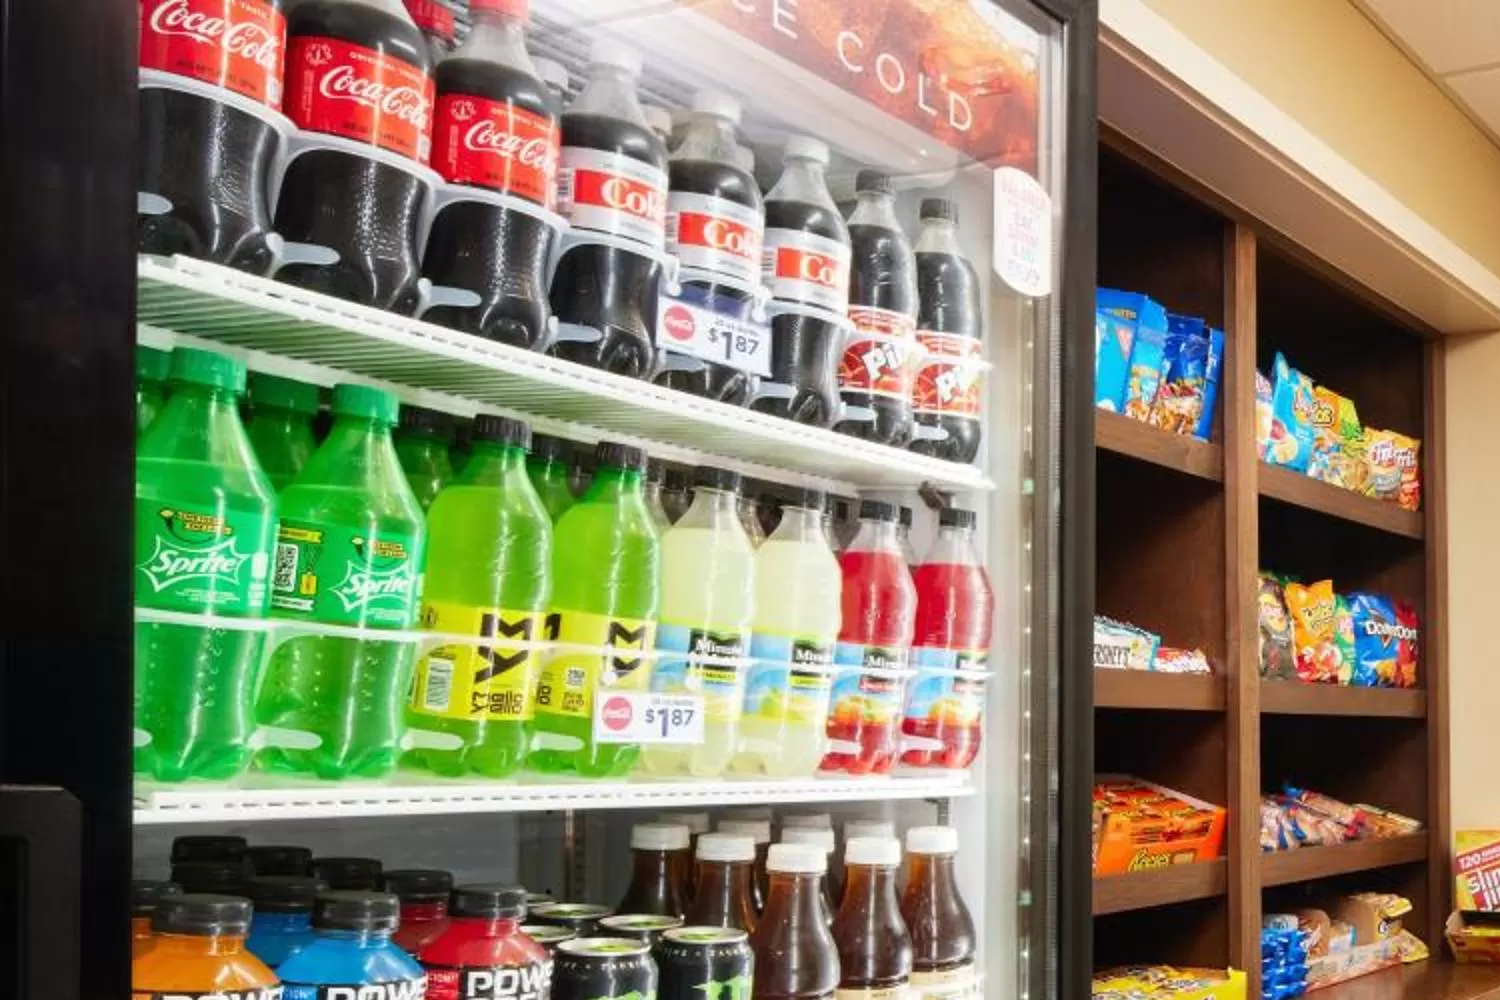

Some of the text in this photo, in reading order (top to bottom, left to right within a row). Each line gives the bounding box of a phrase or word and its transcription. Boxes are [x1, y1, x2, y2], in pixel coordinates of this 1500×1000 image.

[837, 31, 972, 131] COLD
[150, 549, 237, 577] Sprite
[644, 707, 695, 737] $187
